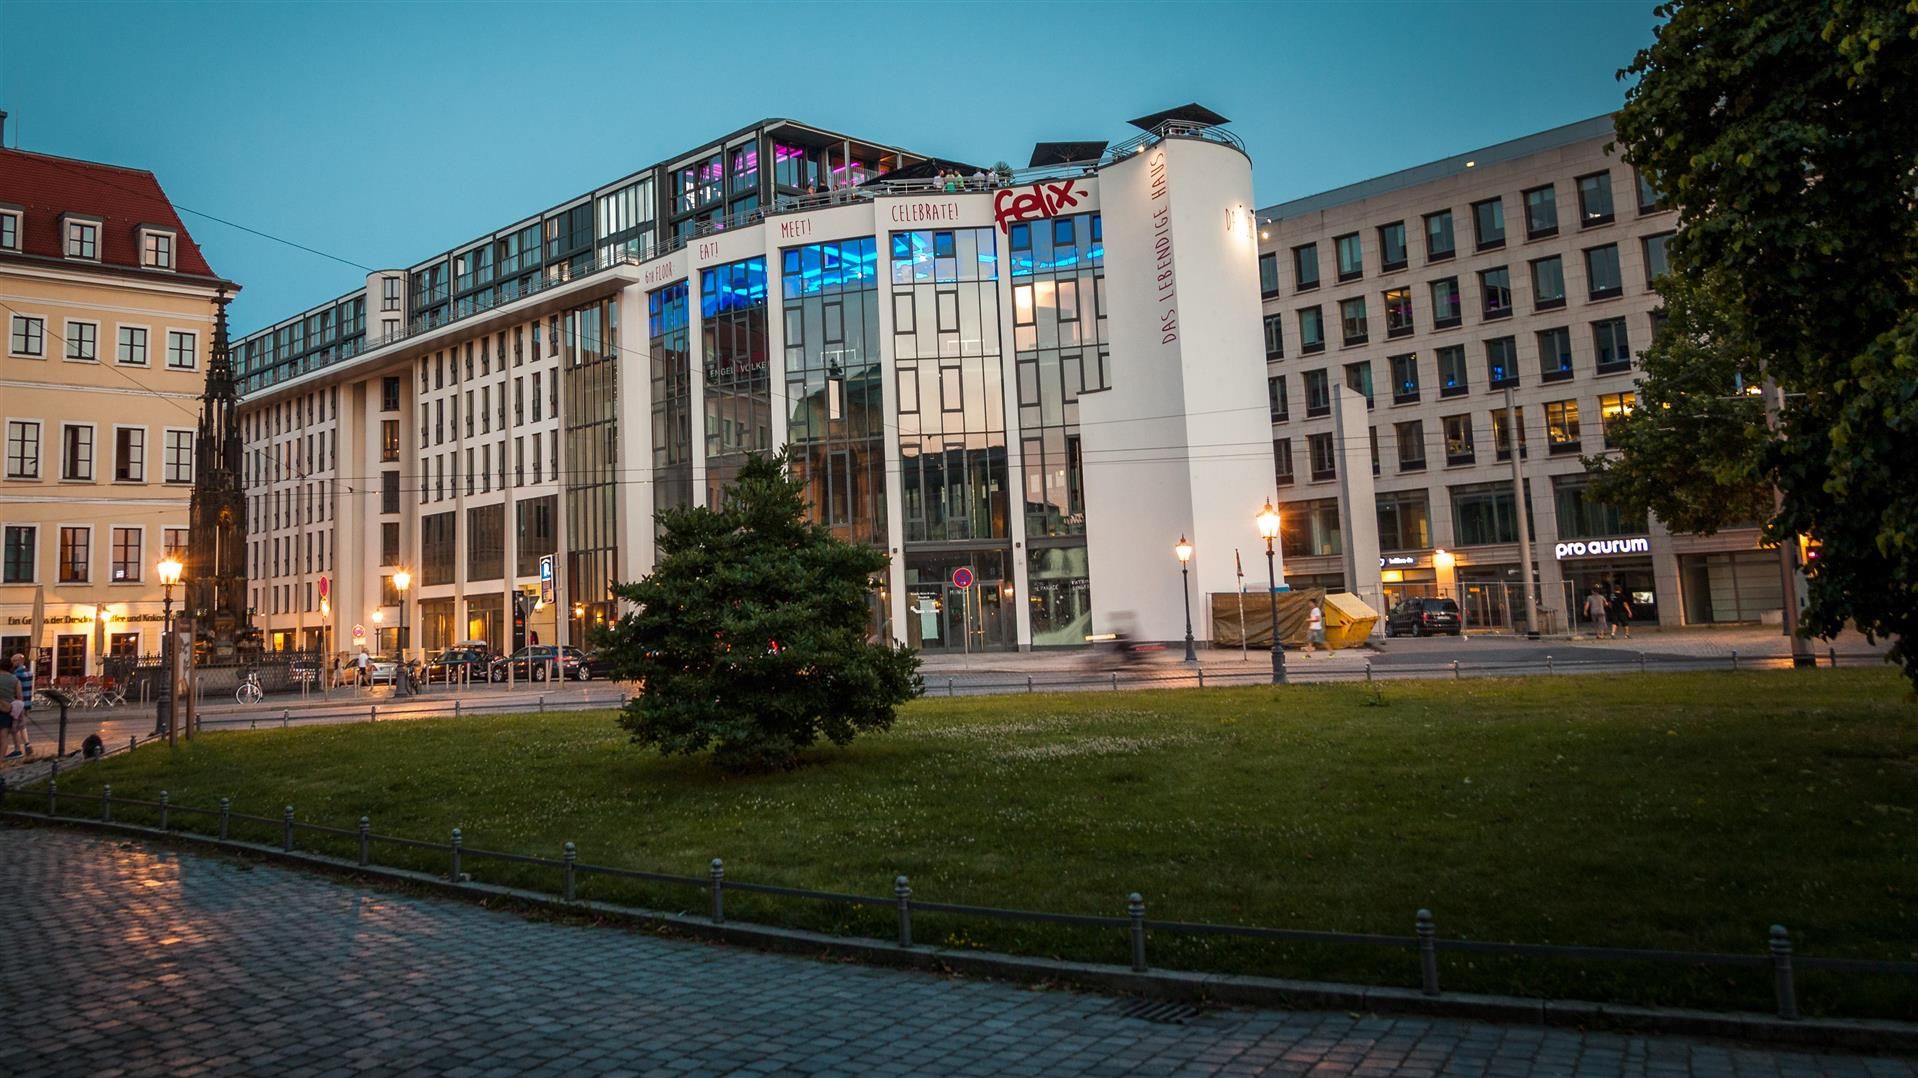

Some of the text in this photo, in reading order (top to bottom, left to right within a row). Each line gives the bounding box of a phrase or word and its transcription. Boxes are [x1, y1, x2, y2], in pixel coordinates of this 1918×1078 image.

[891, 202, 959, 222] CELEBRATE!
[781, 218, 811, 239] MEET!
[700, 241, 719, 261] EAT!
[1150, 152, 1177, 345] DAS LEBENDIGE HAUS
[655, 261, 673, 281] FLOOR
[1555, 538, 1649, 560] pro aurum
[8, 616, 20, 625] Ein
[51, 615, 64, 624] der
